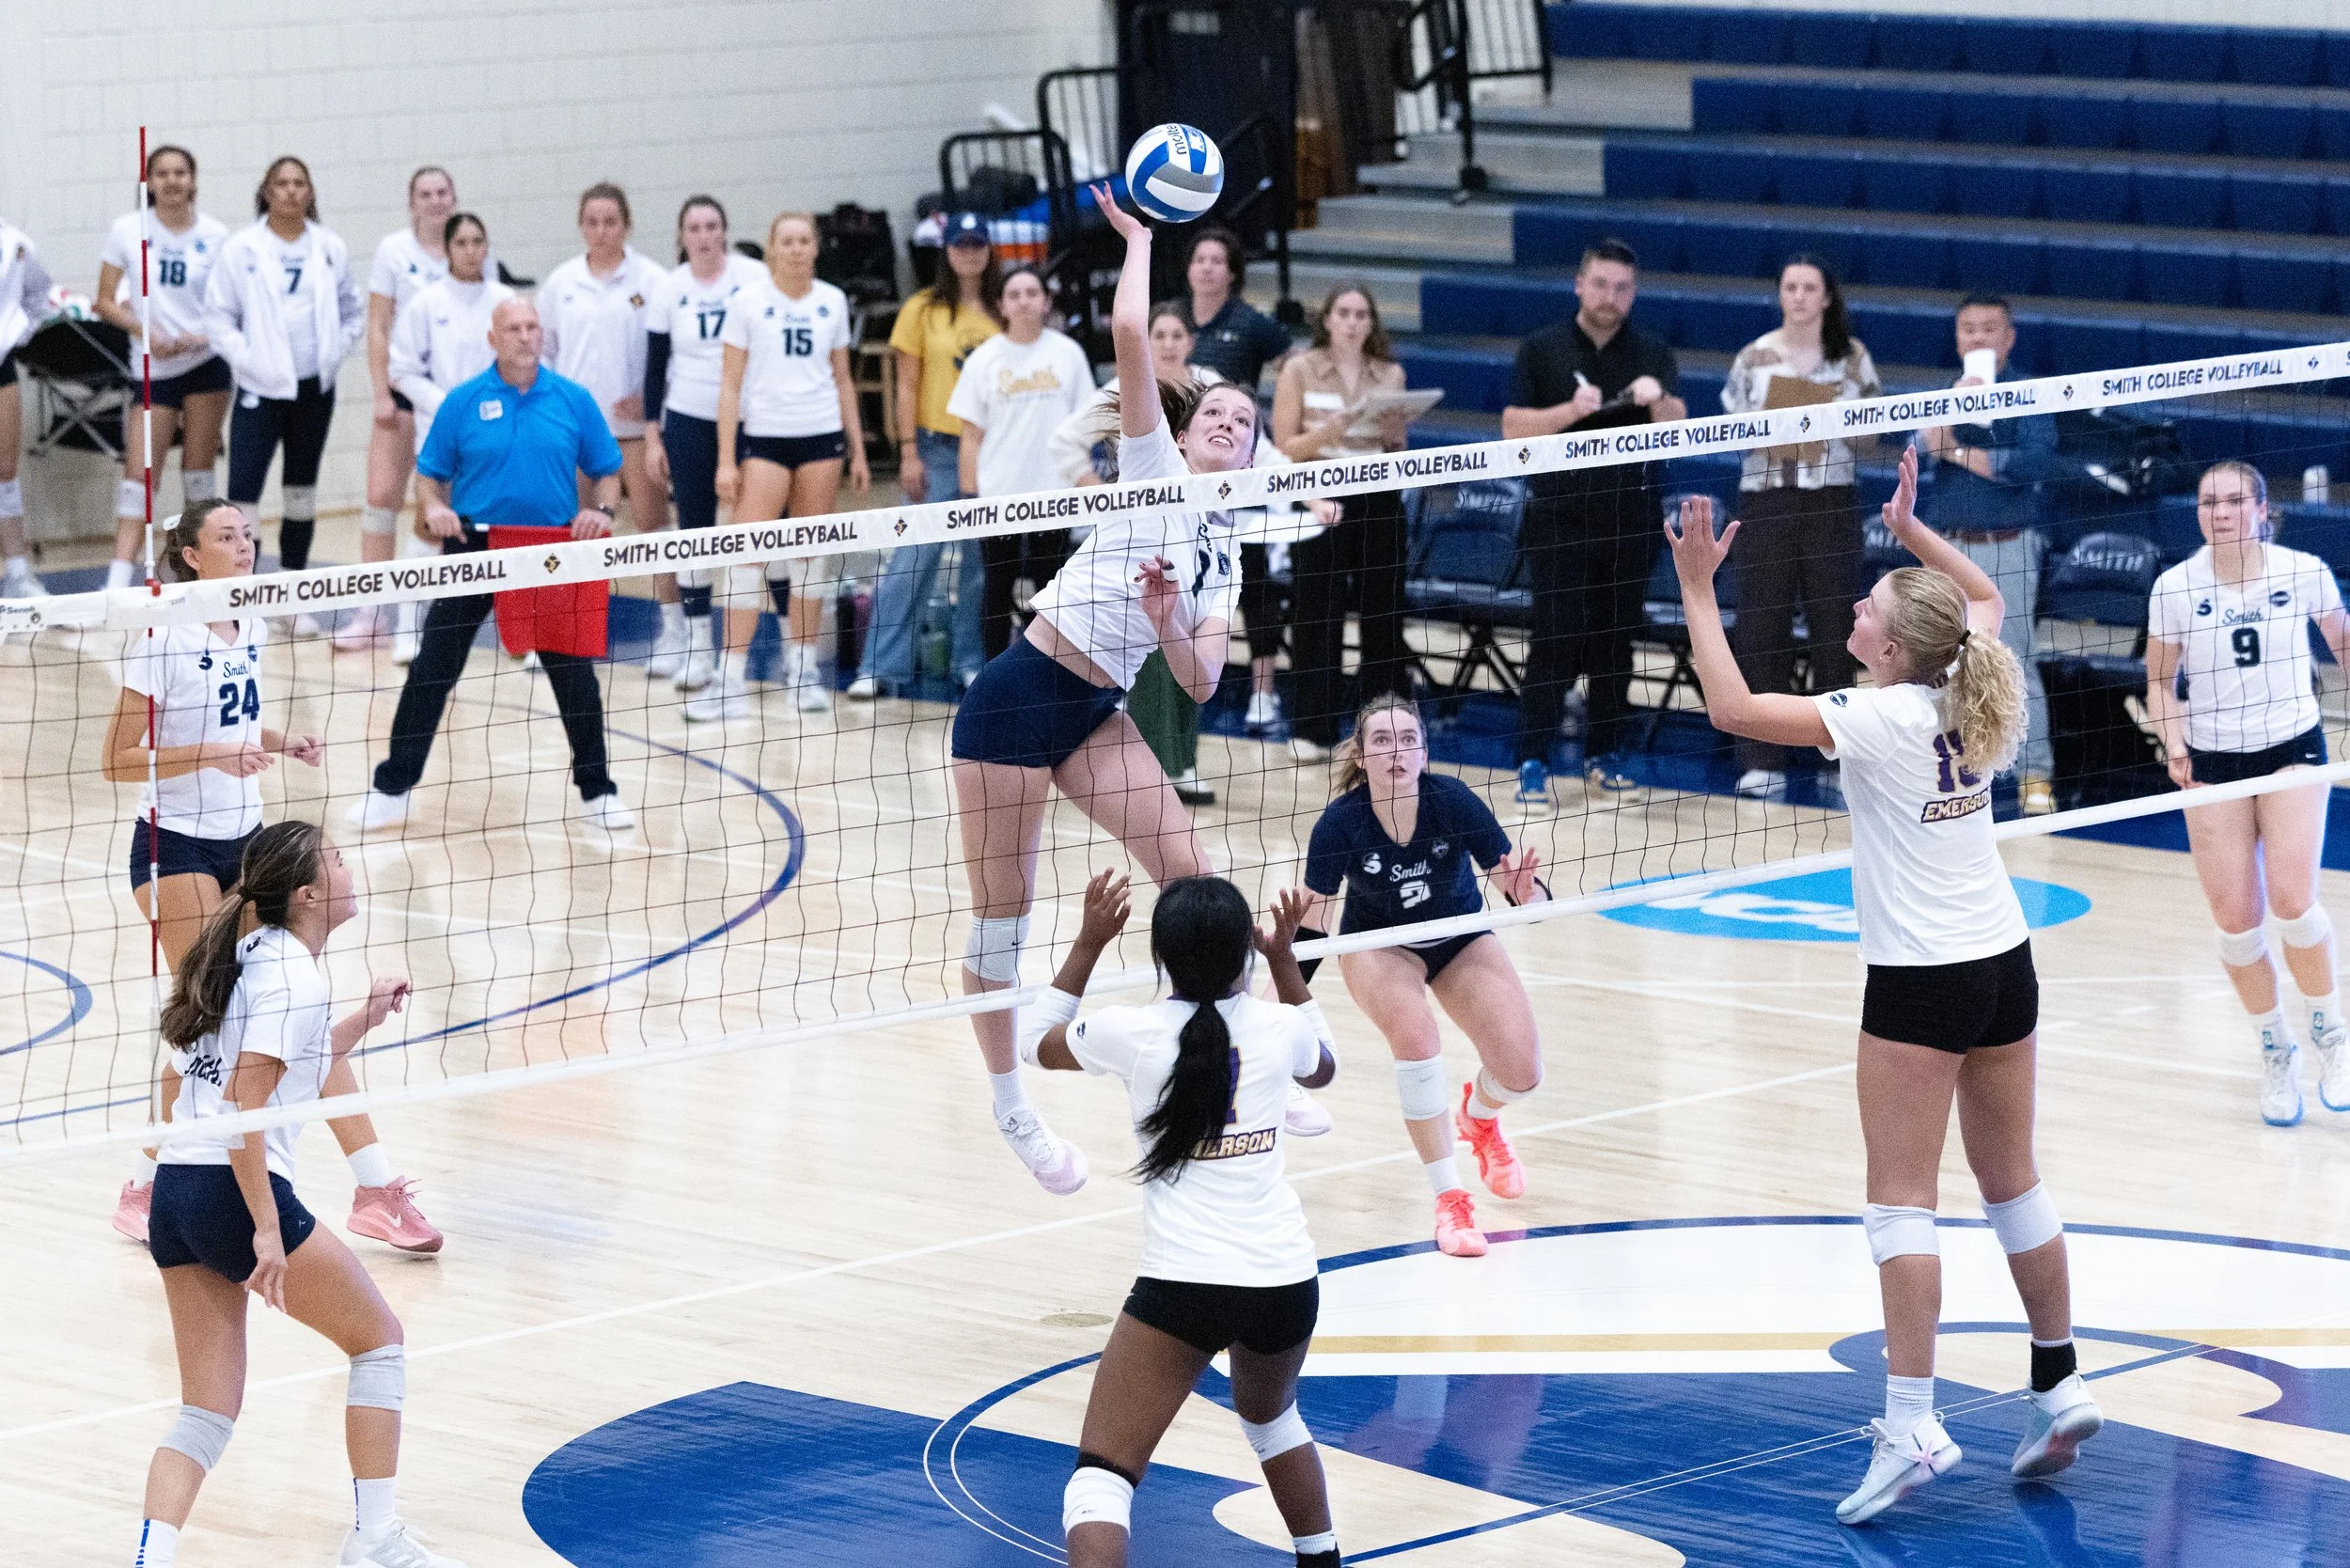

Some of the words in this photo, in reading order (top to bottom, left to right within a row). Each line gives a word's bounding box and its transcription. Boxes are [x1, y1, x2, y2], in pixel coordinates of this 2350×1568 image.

[1167, 124, 1187, 155] molte
[159, 259, 186, 287] 18
[285, 268, 302, 294] 7
[697, 308, 727, 339] 17
[782, 328, 813, 356] 15
[2103, 375, 2141, 396] SMITH
[2147, 368, 2203, 390] COLLEGE
[2207, 359, 2282, 383] VOLLEYBALL
[1843, 405, 1885, 426] SMITH
[1889, 398, 1950, 421] COLLEGE
[1954, 388, 2036, 414] VOLLEYBALL
[1565, 437, 1610, 459] SMITH
[1616, 430, 1679, 453] COLLEGE
[1684, 419, 1771, 446] VOLLEYBALL
[1267, 469, 1315, 494] SMITH
[1320, 462, 1389, 487] COLLEGE
[1395, 451, 1488, 478] VOLLEYBALL
[947, 505, 998, 529] SMITH
[1005, 496, 1079, 523] COLLEGE
[1083, 485, 1185, 513] VOLLEYBALL
[603, 542, 659, 567] SMITH
[664, 533, 745, 560] COLLEGE
[750, 522, 858, 550] VOLLEYBALL
[228, 582, 289, 608] SMITH
[297, 572, 383, 601] COLLEGE
[390, 559, 507, 590] VOLLEYBALL
[2222, 607, 2264, 625] Smith
[2232, 627, 2261, 667] 9
[223, 661, 250, 679] Smith
[219, 678, 260, 728] 24
[1389, 859, 1433, 883] Smith
[1191, 1128, 1277, 1161] ERSON
